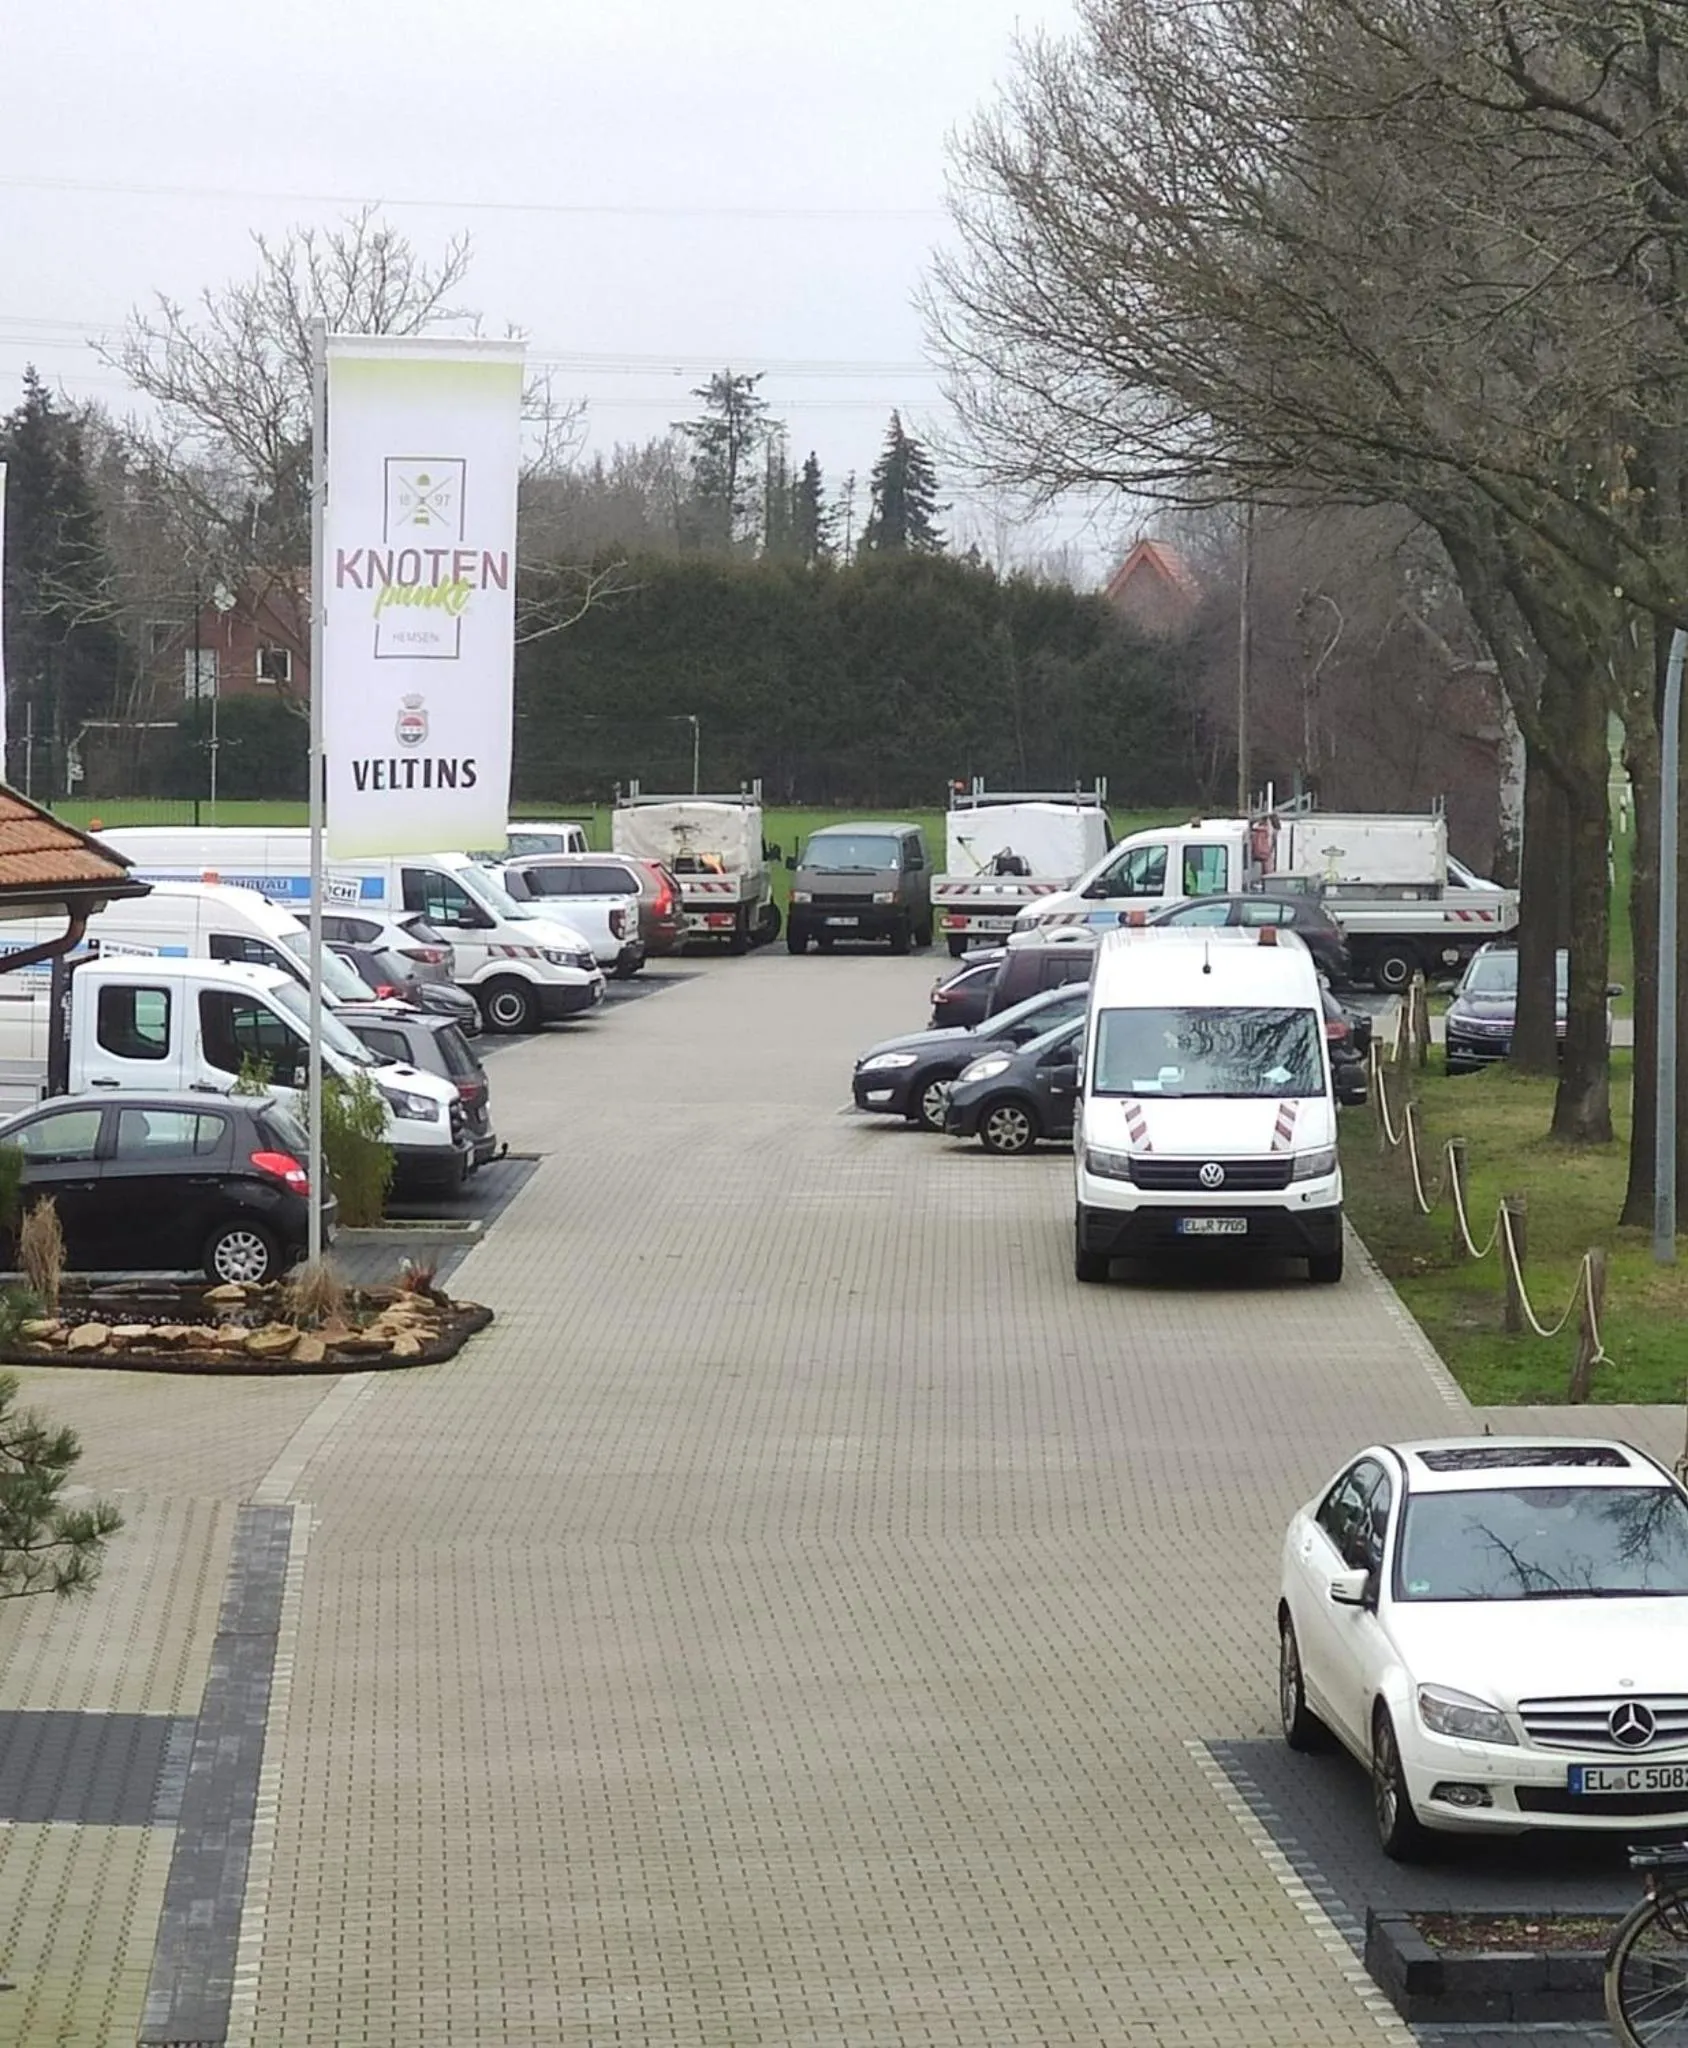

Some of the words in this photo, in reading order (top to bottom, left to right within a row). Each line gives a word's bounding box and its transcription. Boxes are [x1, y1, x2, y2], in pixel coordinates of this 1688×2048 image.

[435, 494, 451, 507] 97
[336, 548, 508, 590] KNOTEN
[373, 574, 471, 619] punkt
[392, 631, 440, 645] HEMSEN
[352, 758, 477, 791] VELTINS
[1184, 1219, 1200, 1231] EL
[1585, 1770, 1612, 1790] EL
[1627, 1769, 1641, 1789] C
[1645, 1767, 1688, 1788] 508
